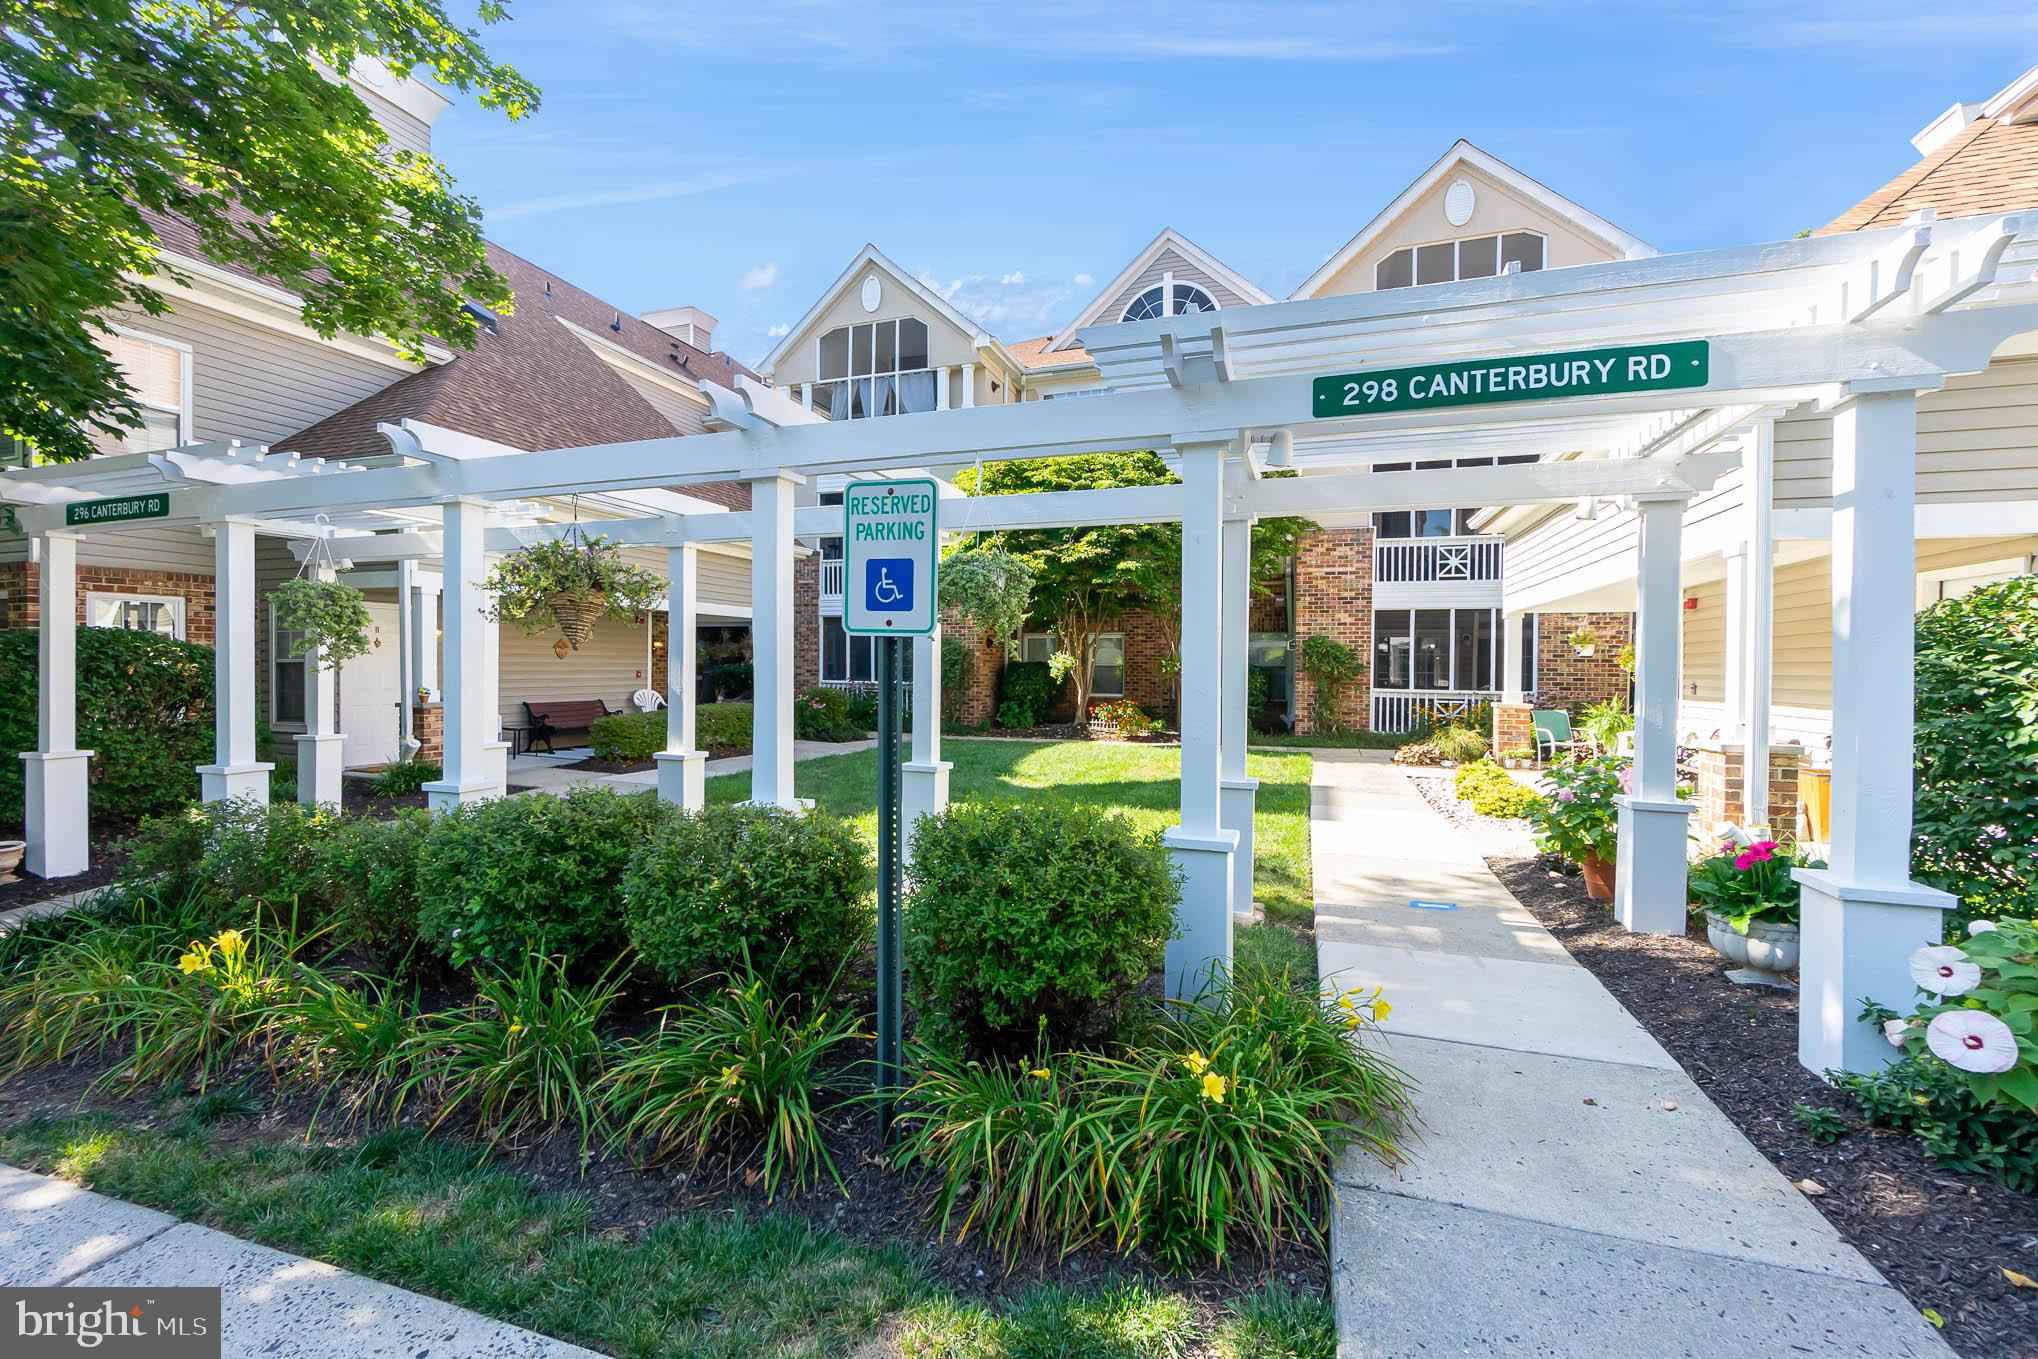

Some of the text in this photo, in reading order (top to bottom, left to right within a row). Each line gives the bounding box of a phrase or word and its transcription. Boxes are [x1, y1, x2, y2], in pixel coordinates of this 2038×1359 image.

[1342, 354, 1671, 406] 298 CANTERBURY RD
[74, 499, 160, 520] 296 CANTERBURY RD
[851, 494, 931, 515] RESERVED
[856, 521, 925, 541] PARKING
